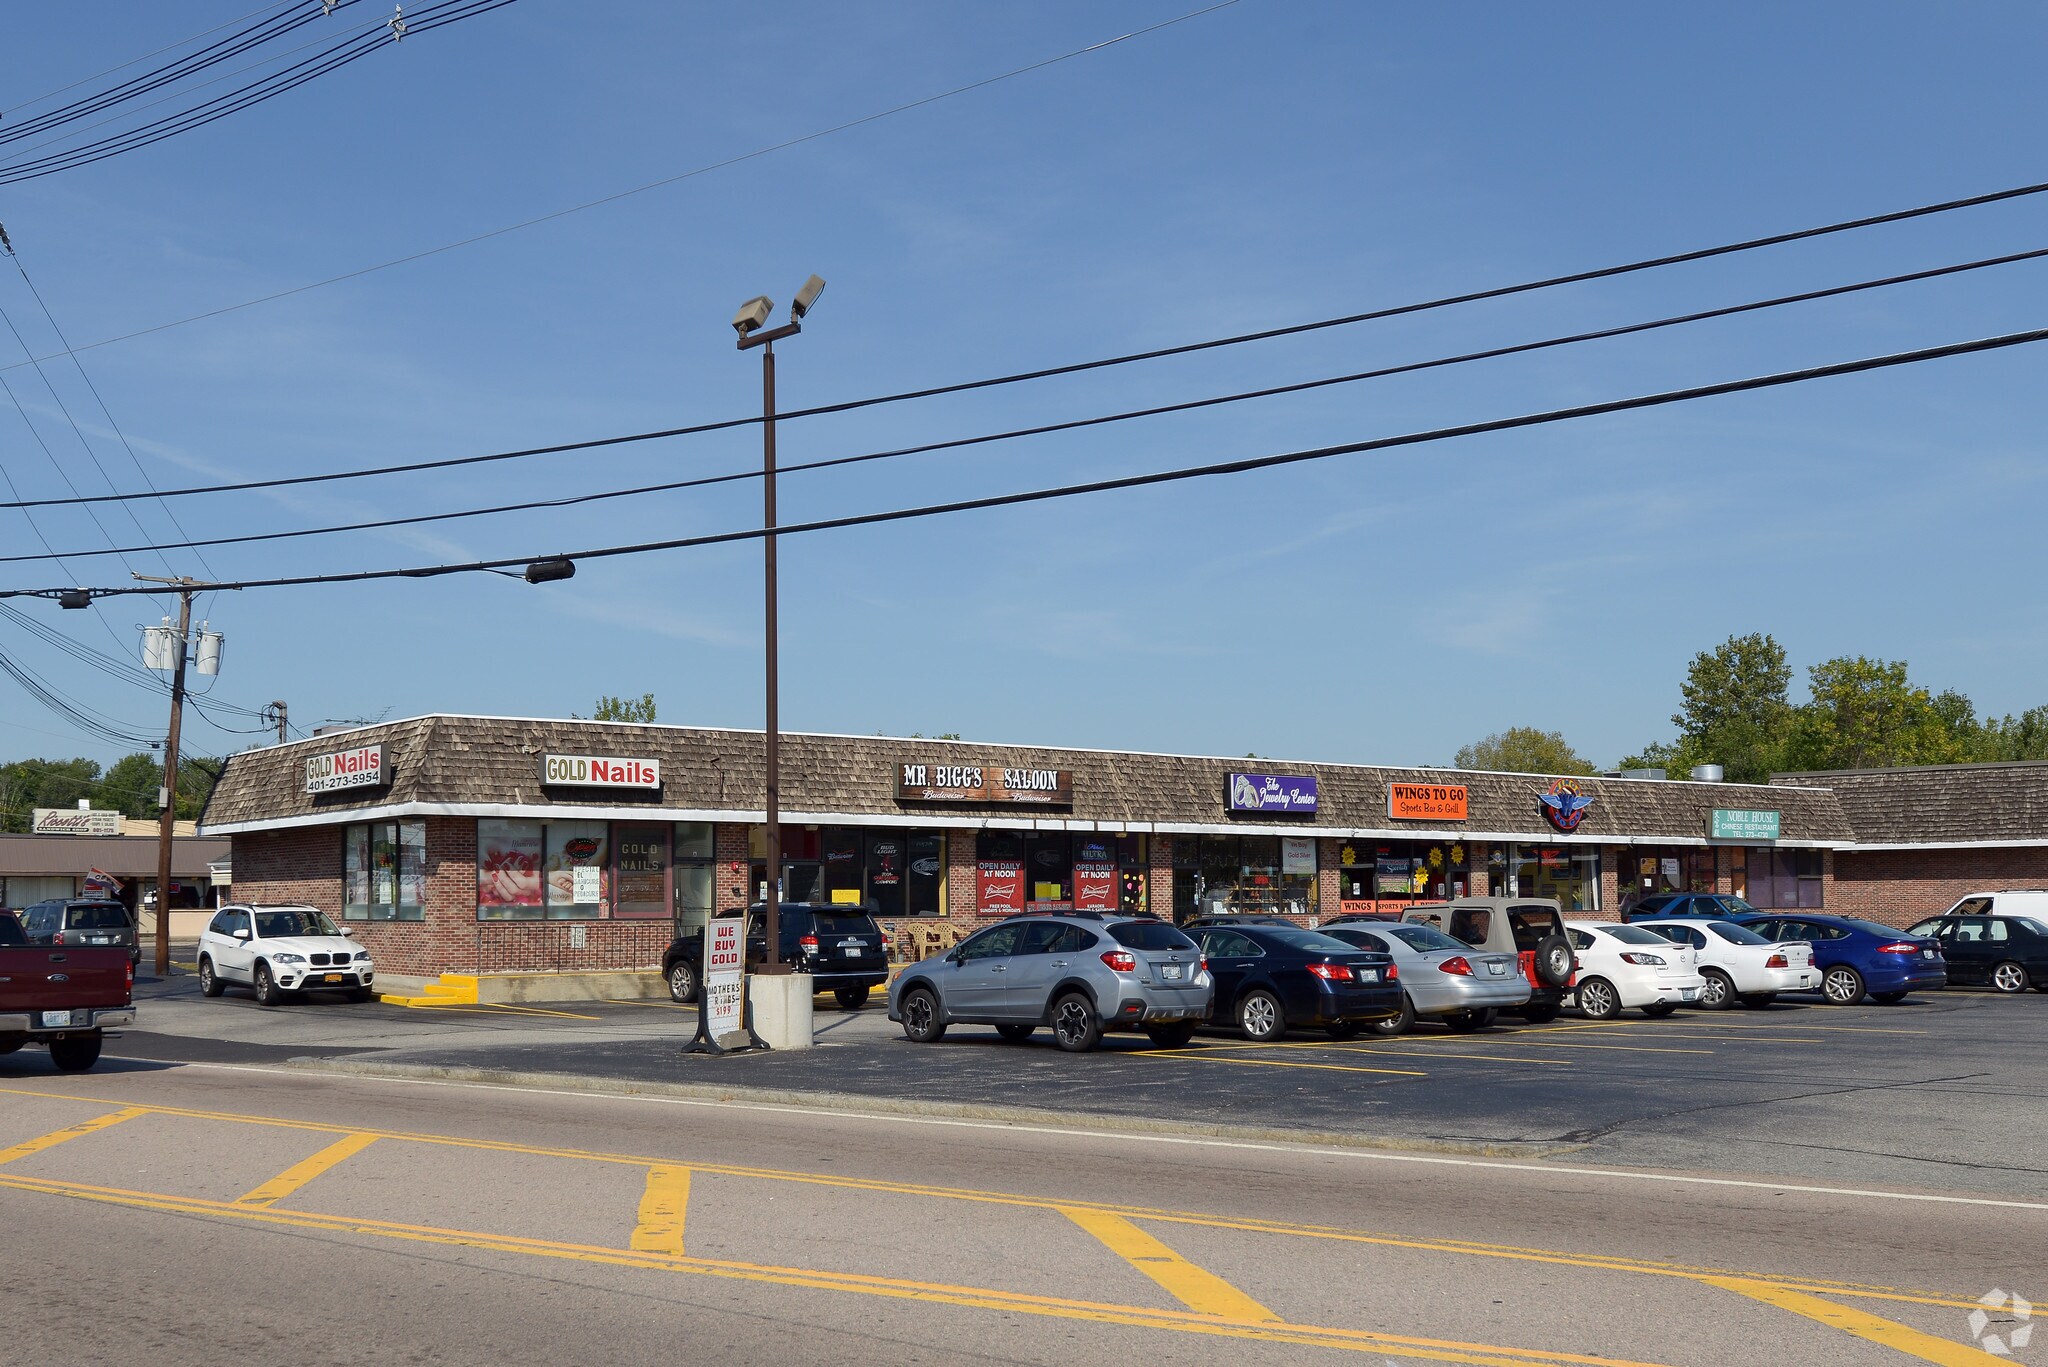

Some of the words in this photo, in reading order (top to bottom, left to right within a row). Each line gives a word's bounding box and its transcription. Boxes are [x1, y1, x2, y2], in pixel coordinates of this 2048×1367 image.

[308, 756, 332, 779] GOLD
[334, 749, 380, 775] Nails
[547, 758, 587, 781] GOLD
[591, 760, 655, 784] Nails
[903, 764, 931, 787] MR.
[936, 765, 982, 788] BIGG'S
[1004, 768, 1058, 790] SALOON
[308, 770, 379, 791] 401-273-5954
[1265, 776, 1280, 791] The
[922, 789, 966, 800] Budweiser
[1011, 791, 1052, 802] Budweiser
[1259, 787, 1291, 809] Jewelry
[1290, 788, 1316, 805] Center
[1394, 786, 1431, 800] WINGS
[1433, 788, 1447, 801] TO
[1449, 789, 1464, 801] GO
[1400, 801, 1422, 815] Sports
[1423, 802, 1436, 813] Bar
[1437, 804, 1444, 813] &
[1445, 803, 1459, 814] Grill
[1727, 810, 1749, 822] NOBLE
[1751, 811, 1774, 823] HOUSE
[1744, 823, 1778, 831] RESTAURANT
[1732, 830, 1744, 838] TEL:
[621, 843, 659, 855] GOLD
[620, 860, 660, 871] NAILS
[978, 862, 999, 870] OPEN
[1000, 862, 1021, 870] DAILY
[984, 870, 994, 878] AT
[995, 870, 1016, 878] NOON
[1081, 871, 1089, 879] AT
[1090, 871, 1110, 879] NOON
[1344, 902, 1372, 910] WINGS
[717, 926, 734, 938] WE
[714, 939, 736, 951] BUY
[711, 953, 738, 965] GOLD
